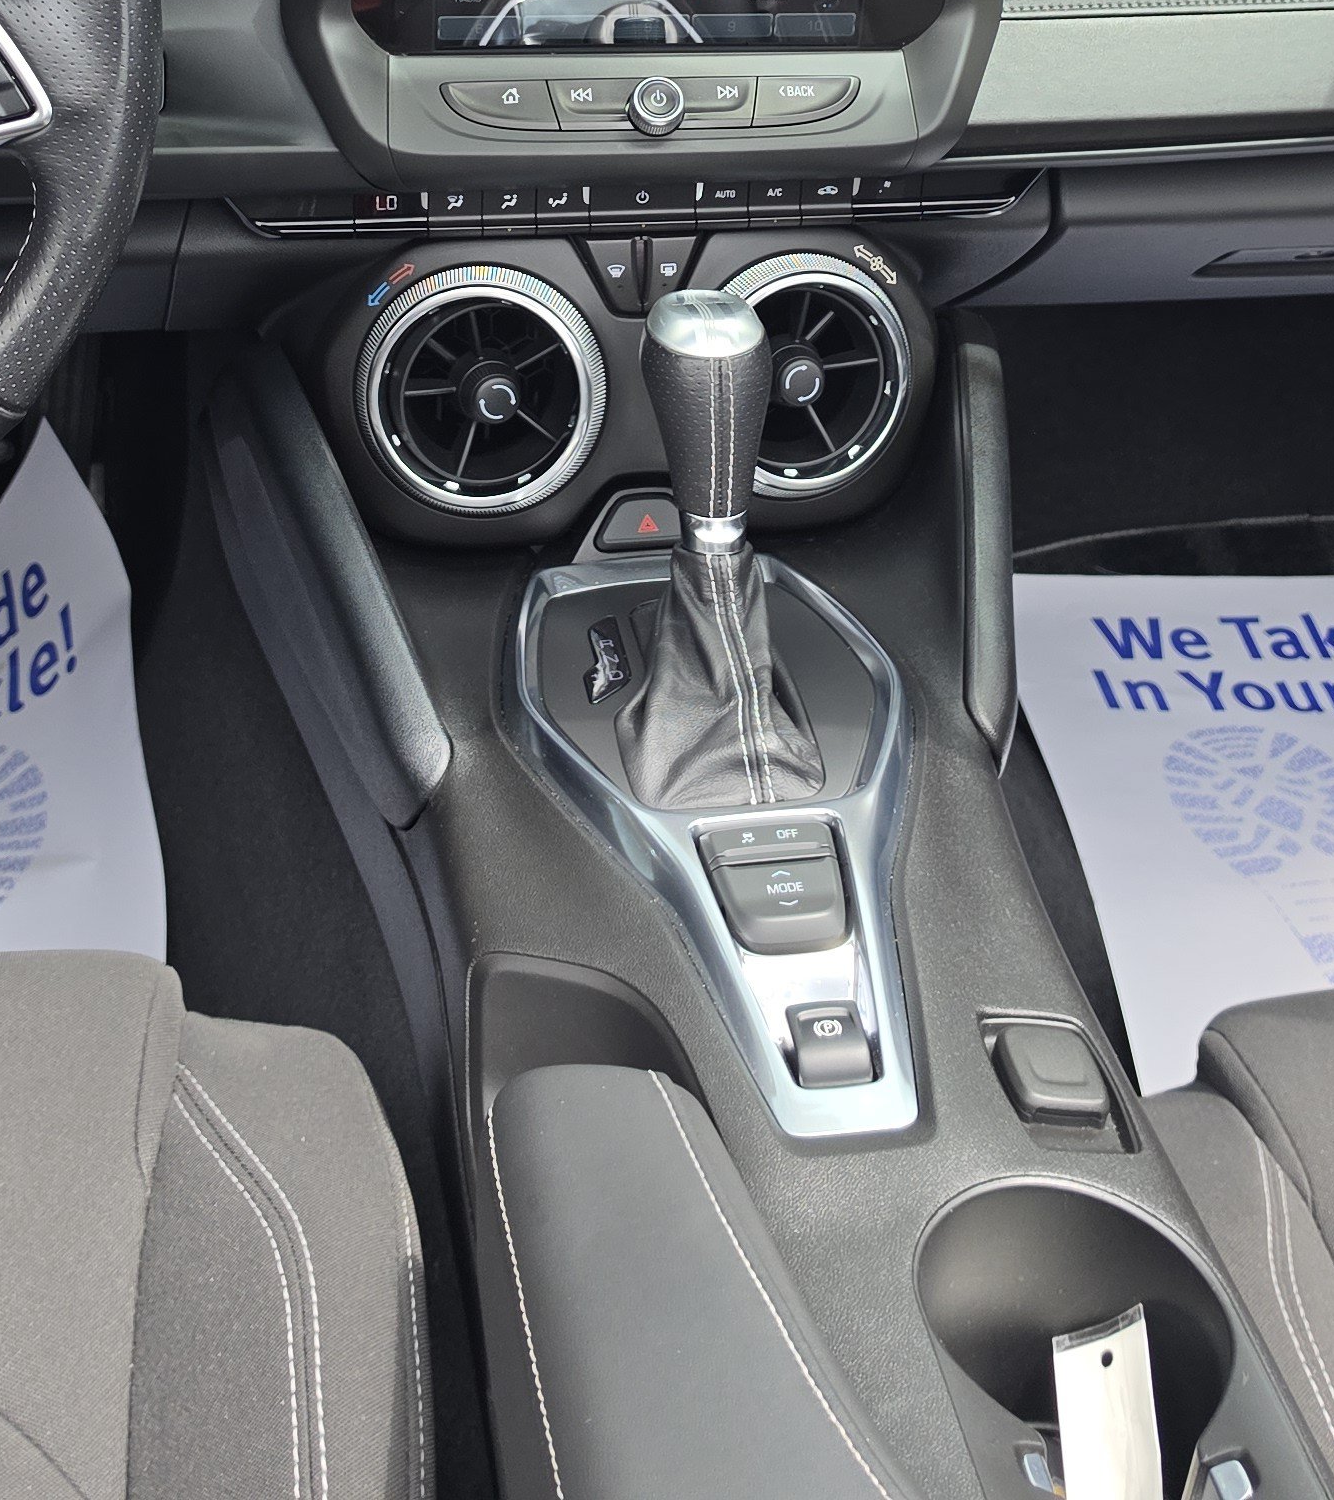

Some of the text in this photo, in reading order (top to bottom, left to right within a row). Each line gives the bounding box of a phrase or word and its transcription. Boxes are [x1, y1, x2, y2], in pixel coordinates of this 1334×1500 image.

[786, 83, 816, 99] BACK
[714, 189, 737, 199] AUTO
[766, 187, 783, 197] A/C
[375, 195, 398, 211] LO
[1091, 616, 1213, 660] We
[1092, 668, 1170, 712] In
[775, 828, 799, 840] OFF
[766, 881, 805, 895] MODE
